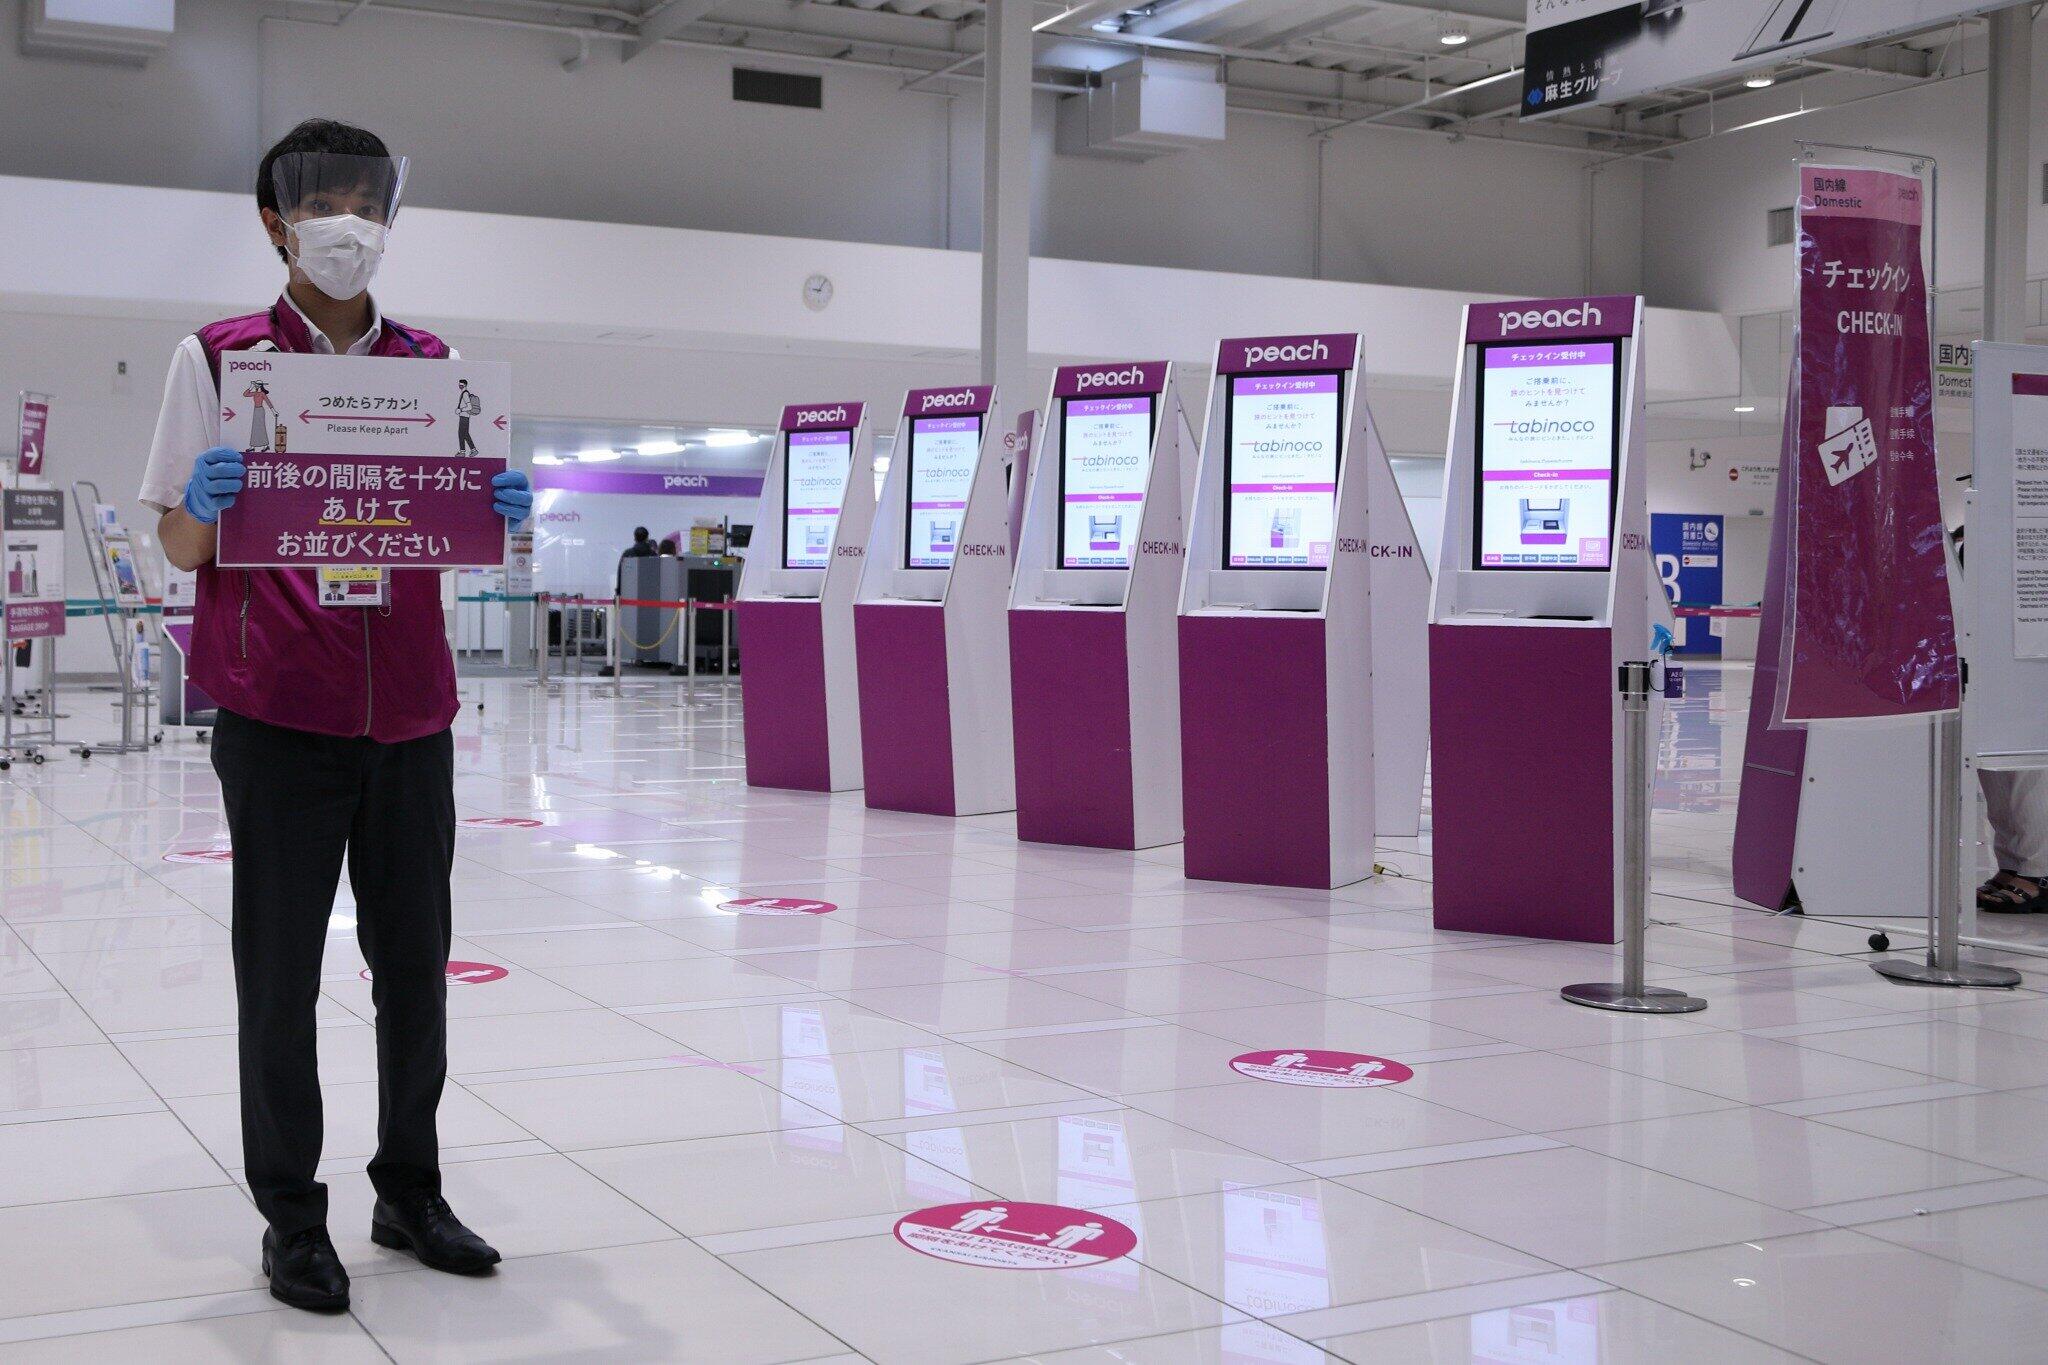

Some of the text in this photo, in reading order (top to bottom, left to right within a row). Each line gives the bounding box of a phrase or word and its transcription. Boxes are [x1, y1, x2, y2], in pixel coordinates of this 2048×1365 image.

[1545, 68, 1622, 103] 麻生グループ
[1814, 177, 1847, 193] 国内線
[1814, 194, 1862, 208] Domestic
[1822, 260, 1910, 292] チェックイン
[1498, 302, 1602, 336] peach
[1837, 310, 1902, 336] CHECK-IN
[1244, 339, 1328, 367] peach
[1511, 351, 1586, 361] チェックイン受付中
[1939, 344, 1973, 366] 国内
[229, 360, 272, 372] peach
[1076, 366, 1144, 392] peach
[318, 396, 418, 410] つめたらアカン!
[922, 389, 975, 412] peach
[797, 405, 847, 427] peach
[327, 424, 408, 436] Please Keep Apart
[1510, 418, 1595, 434] tabinoco
[1254, 439, 1323, 452] tabinoco
[1082, 454, 1139, 466] tabinoco
[247, 462, 482, 491] 前後の間隔を十分に
[663, 475, 709, 489] peach
[322, 497, 410, 522] あけて
[539, 510, 581, 523] peach
[277, 531, 450, 558] お並びください
[963, 544, 1005, 556] CHECK-IN
[1143, 541, 1179, 554] CHECK-IN
[1338, 538, 1367, 552] CHECK-IN
[1371, 545, 1412, 558] CK-IN
[1655, 554, 1682, 607] B
[918, 1227, 1077, 1260] Social Distancing
